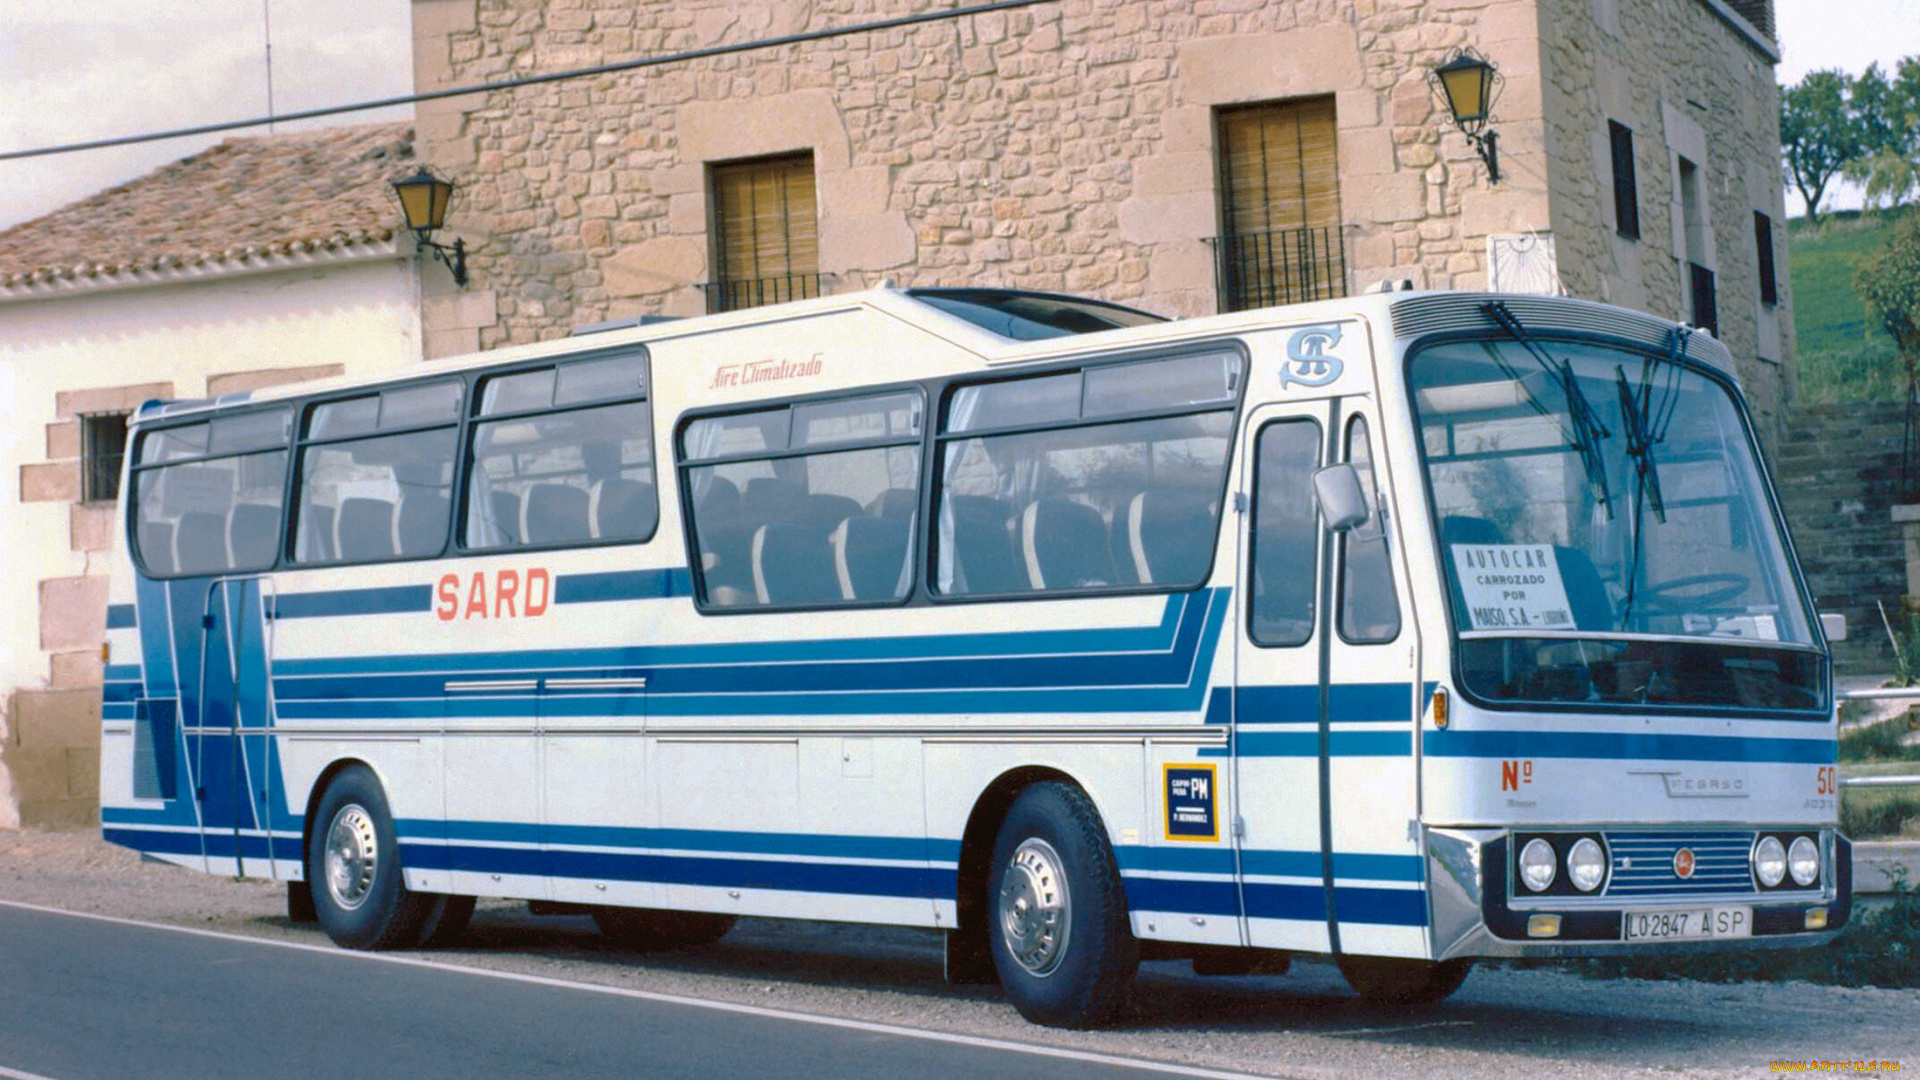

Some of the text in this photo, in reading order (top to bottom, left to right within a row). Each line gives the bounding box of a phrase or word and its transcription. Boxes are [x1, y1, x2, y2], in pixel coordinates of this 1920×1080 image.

[709, 364, 740, 389] Aire
[1466, 549, 1547, 569] AUTOCAR
[1476, 575, 1546, 585] CARROZADO
[437, 567, 550, 621] SARD
[1503, 590, 1526, 600] POR
[1191, 778, 1208, 800] PM
[1671, 779, 1743, 790] PEGASO
[1817, 766, 1836, 795] 50
[1717, 911, 1745, 933] SP
